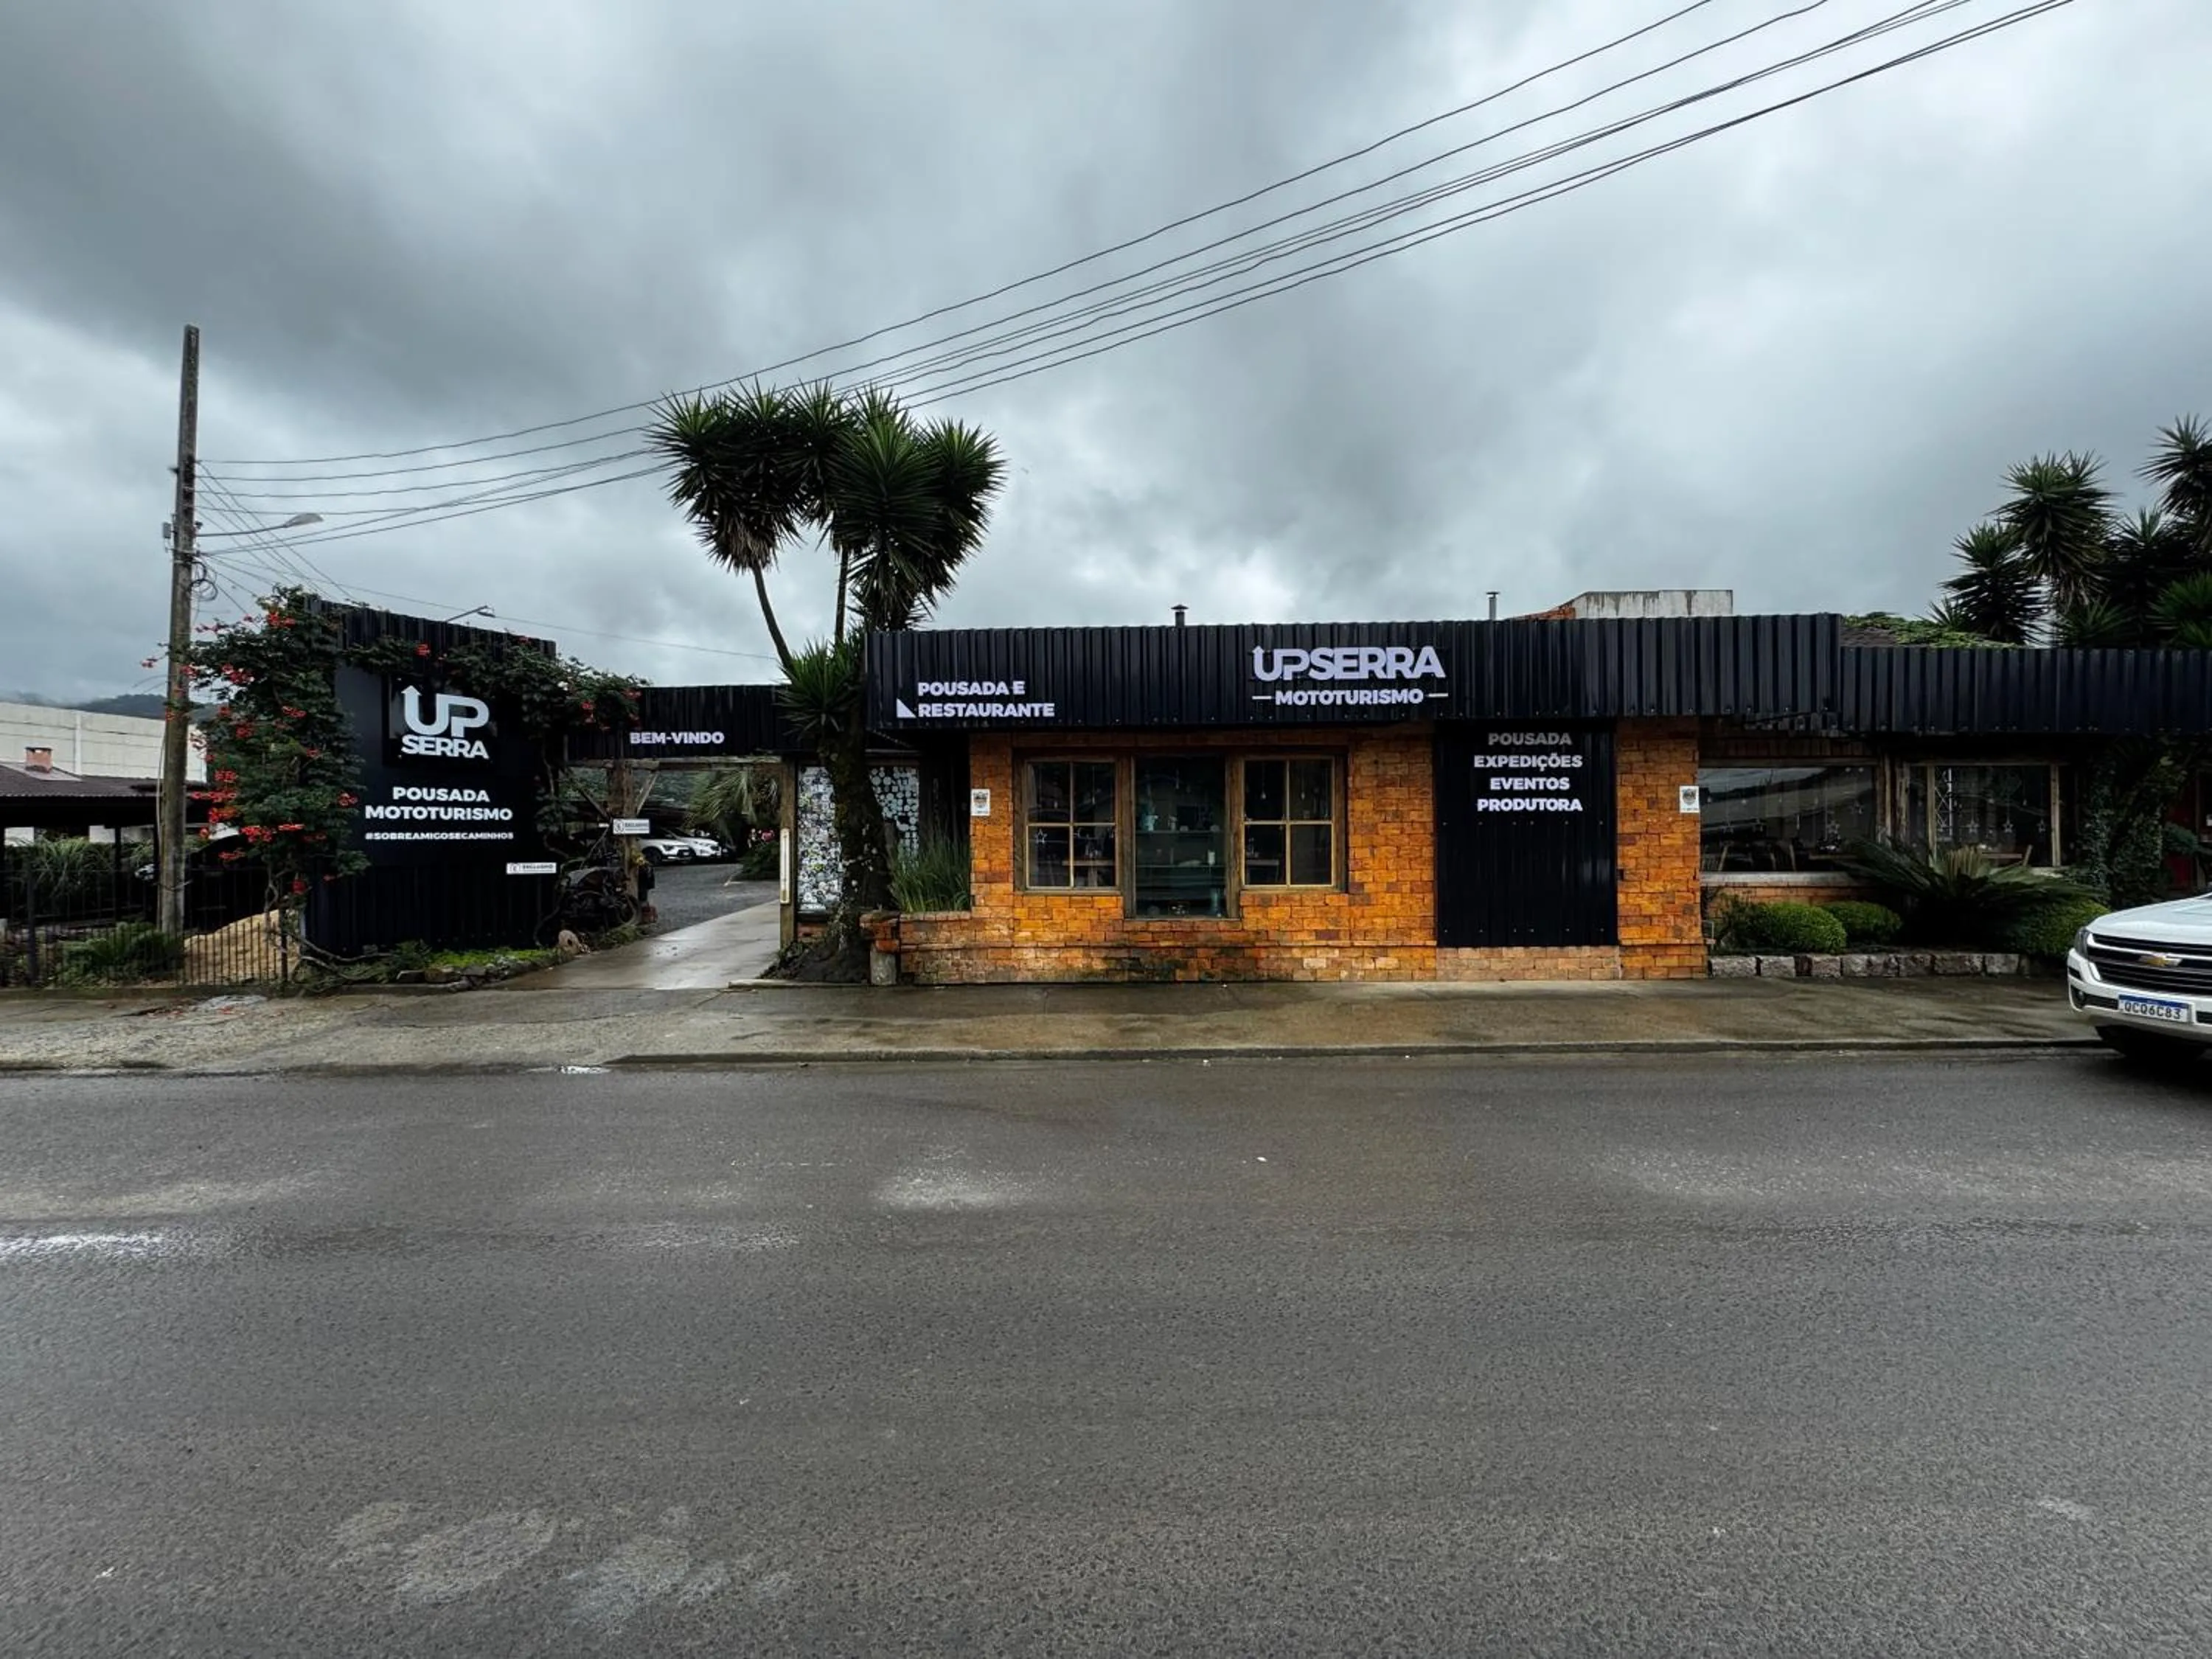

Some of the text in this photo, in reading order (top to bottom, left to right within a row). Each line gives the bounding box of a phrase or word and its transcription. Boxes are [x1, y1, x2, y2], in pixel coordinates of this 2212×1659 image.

[917, 681, 1026, 696] POUSADA E
[1275, 689, 1424, 706] MOTOTURISMO
[401, 685, 490, 737] UP
[918, 703, 1055, 717] RESTAURANTE
[630, 731, 725, 744] BEM-VINDO
[1488, 732, 1572, 745] POUSADA
[401, 734, 490, 759] SERRA
[1474, 752, 1583, 772] EXPEDIÇÕES
[1489, 776, 1571, 790] EVENTOS
[392, 786, 490, 802] POUSADA
[365, 804, 513, 821] MOTOTURISMO
[1477, 798, 1583, 812] PRODUTORA
[365, 832, 513, 840] #SOBREAMIGOSECAMINHOS
